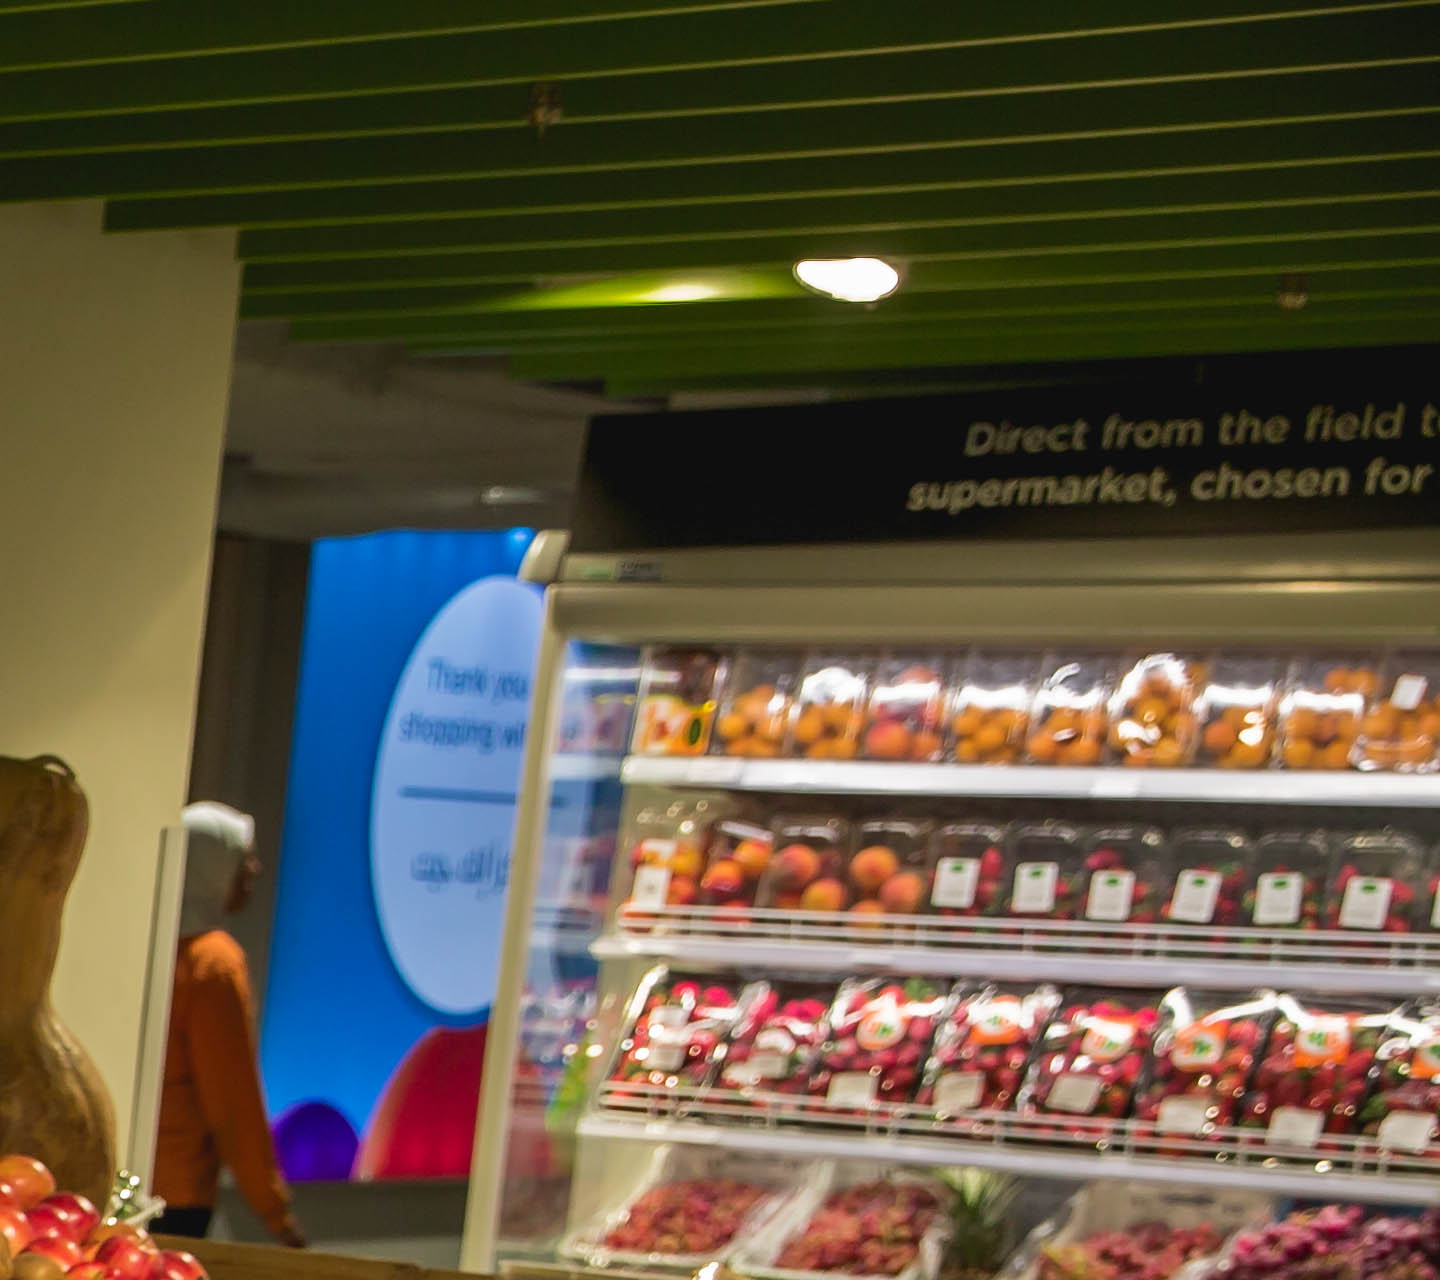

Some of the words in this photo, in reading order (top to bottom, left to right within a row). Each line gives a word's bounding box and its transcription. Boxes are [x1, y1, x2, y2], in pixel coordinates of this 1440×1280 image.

[963, 418, 1089, 458] Direct
[1101, 412, 1205, 451] from
[1217, 409, 1291, 446] the
[1303, 402, 1406, 443] field
[1420, 402, 1440, 440] t
[906, 464, 1178, 516] supermarket,
[1189, 461, 1352, 500] chosen
[1364, 455, 1435, 497] for
